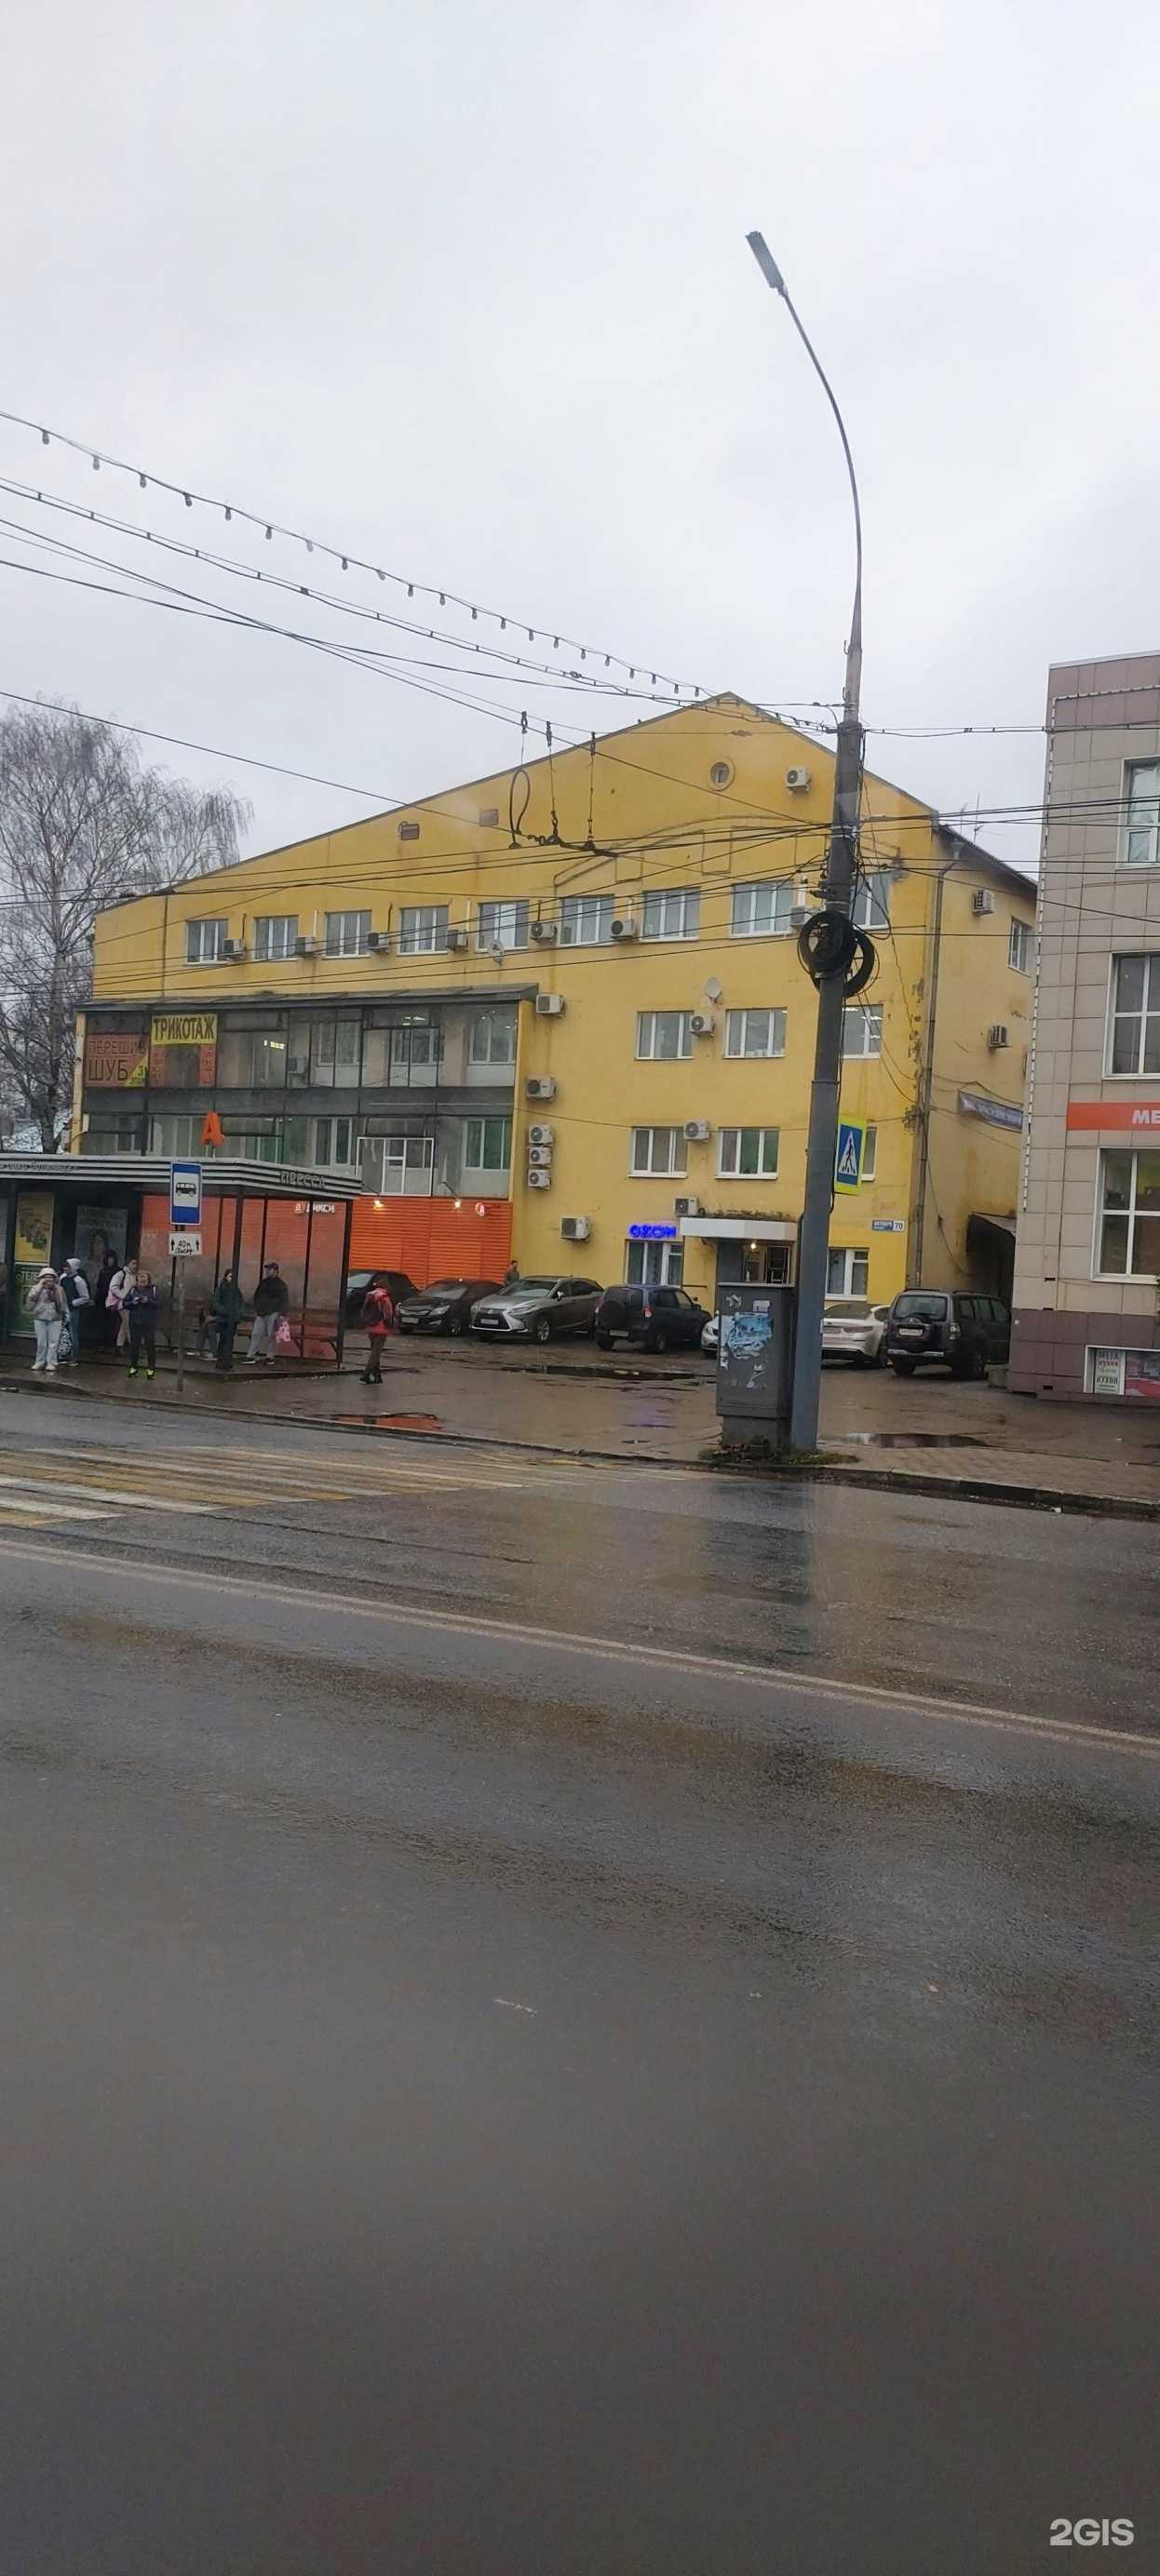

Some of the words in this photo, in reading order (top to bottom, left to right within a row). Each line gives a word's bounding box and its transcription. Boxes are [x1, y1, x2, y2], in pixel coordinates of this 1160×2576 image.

[154, 1016, 215, 1040] ТРИКОТАЖ
[88, 1058, 128, 1081] ШУБ
[281, 1170, 326, 1188] ПРЕССА
[895, 1222, 903, 1230] 70
